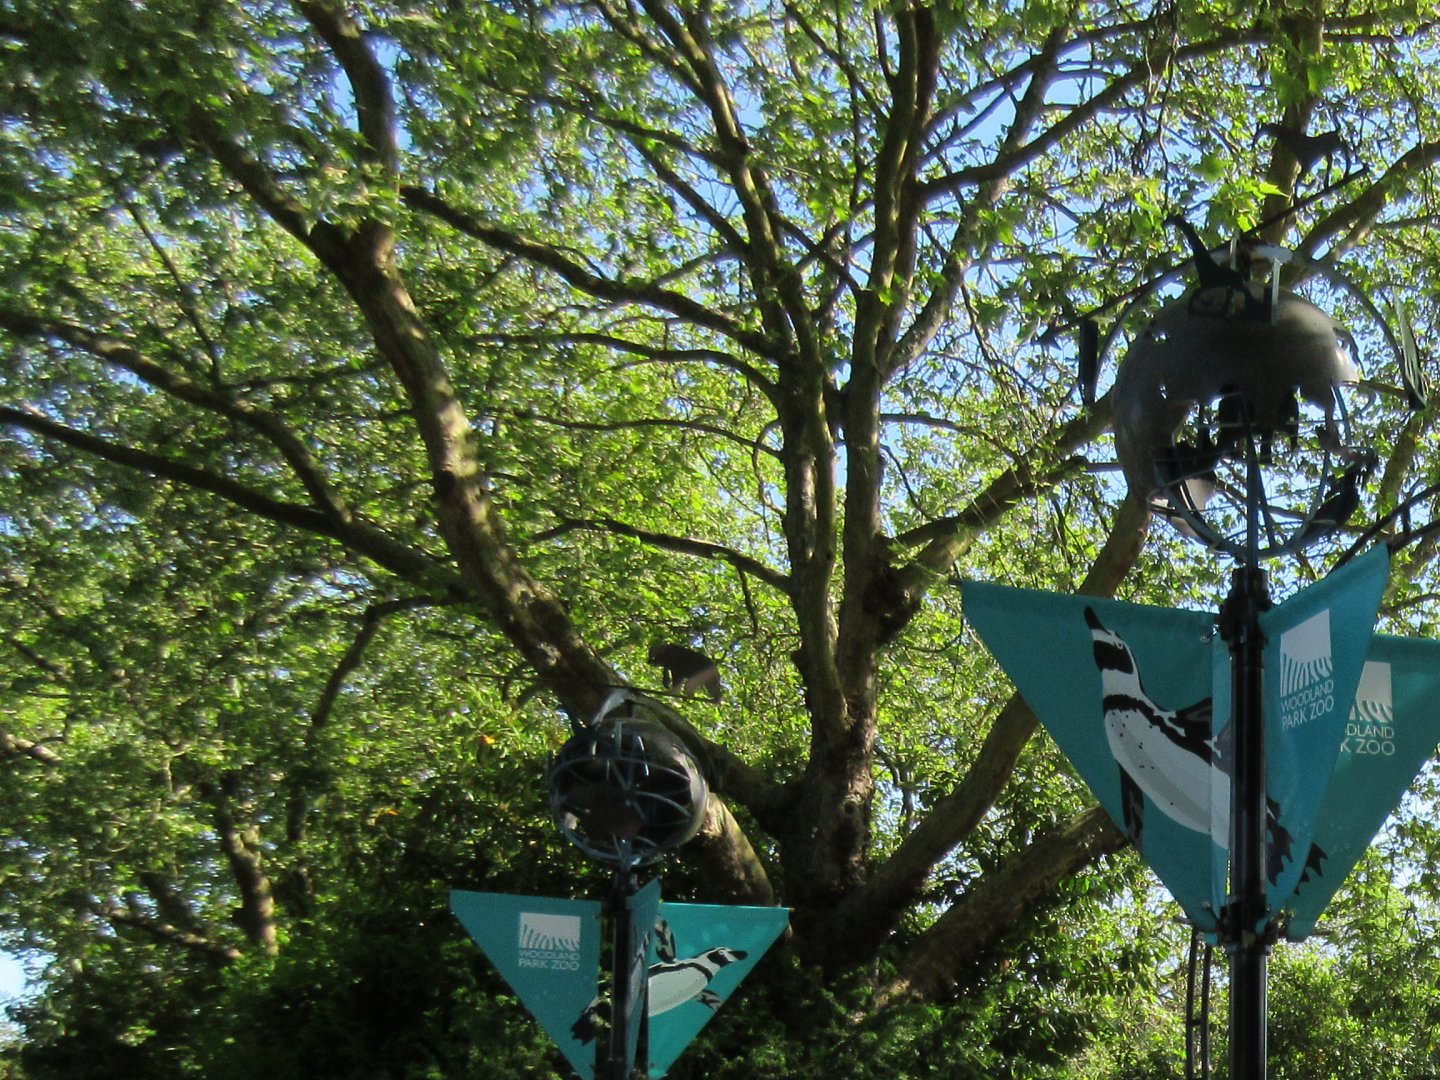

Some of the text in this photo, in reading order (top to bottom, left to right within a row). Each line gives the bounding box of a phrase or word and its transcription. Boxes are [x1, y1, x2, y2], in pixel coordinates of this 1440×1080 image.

[1281, 680, 1334, 713] WOODLAND
[1281, 695, 1334, 732] PARK ZOO
[1345, 722, 1395, 739] DLAND
[1355, 739, 1395, 756] ZOO
[519, 957, 580, 971] PARK ZOO
